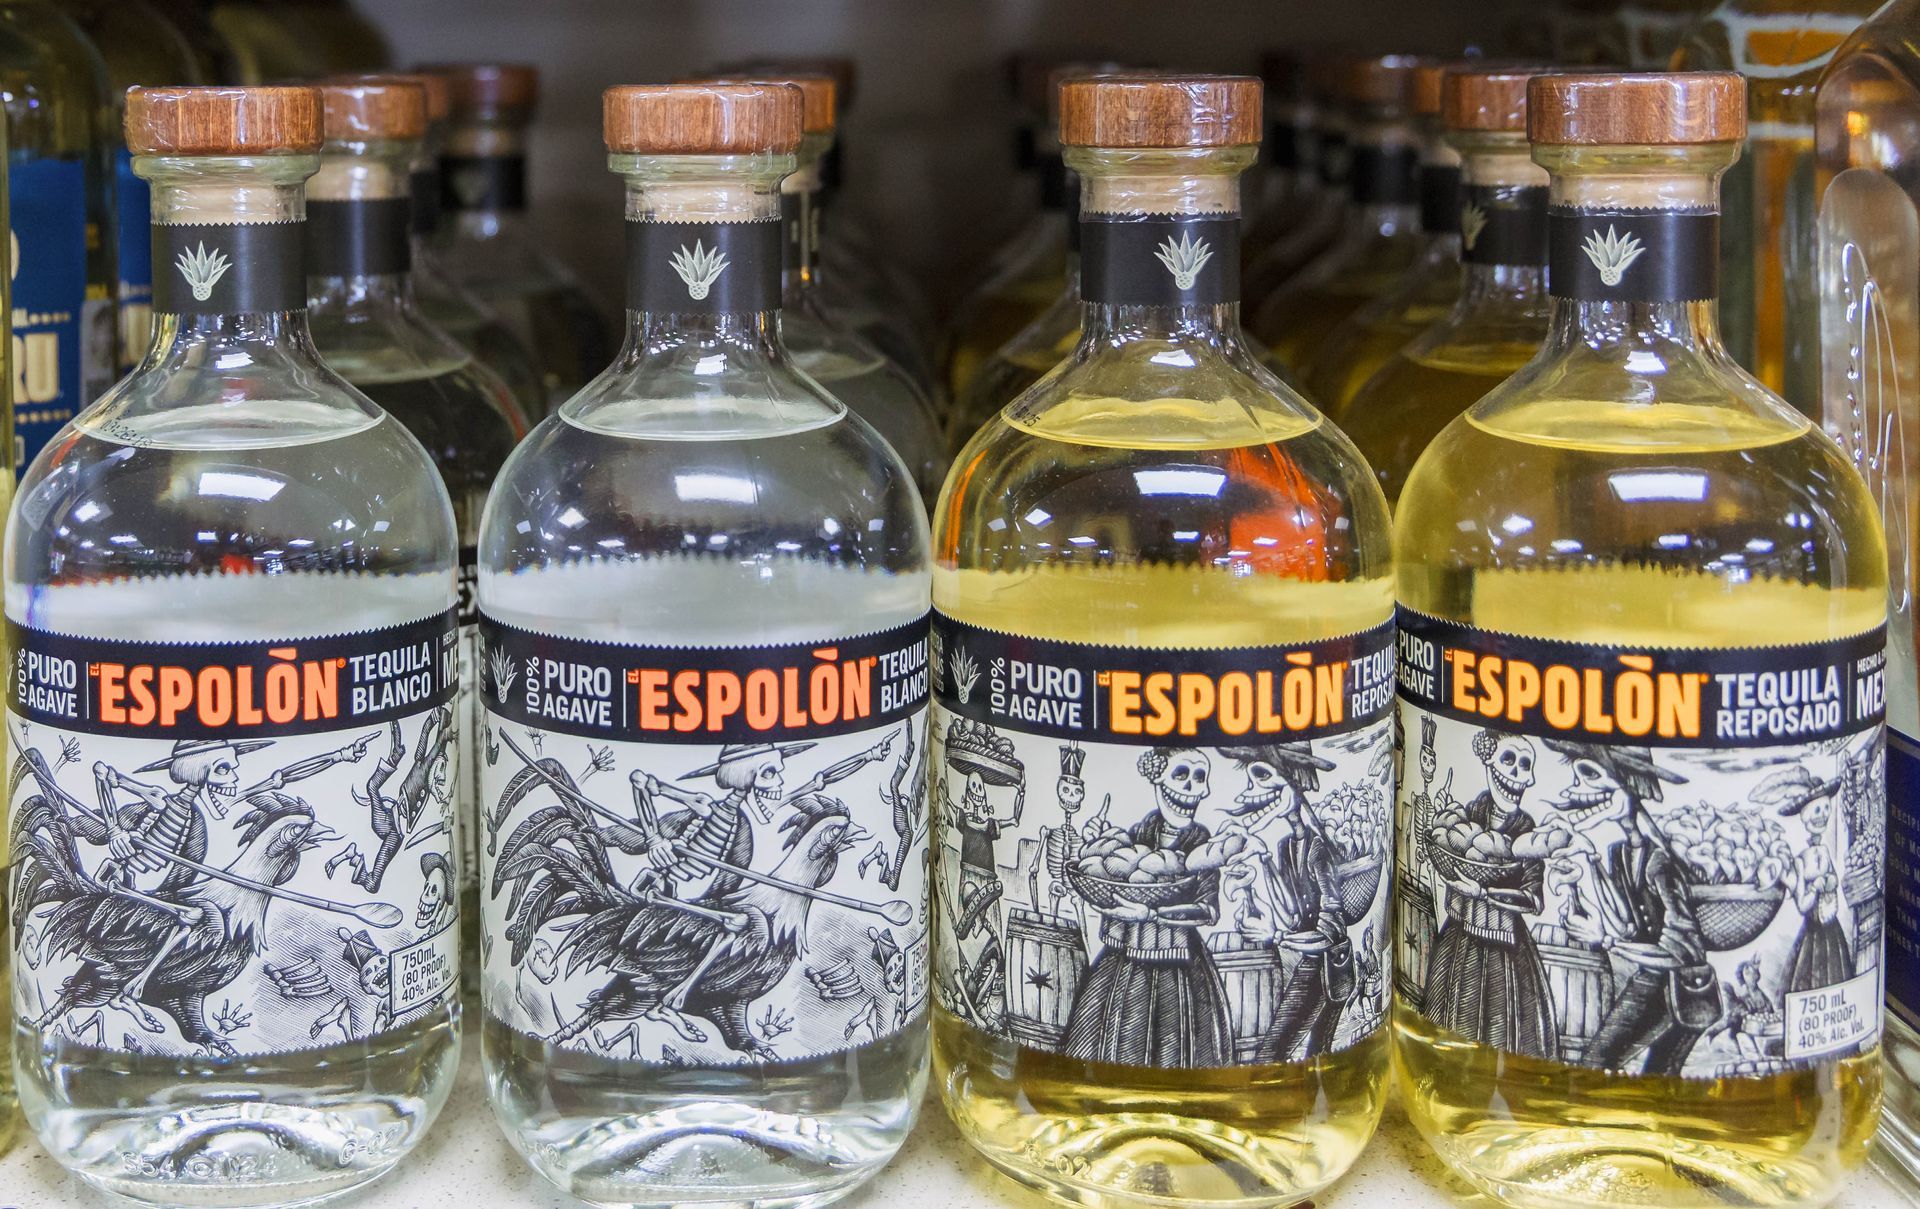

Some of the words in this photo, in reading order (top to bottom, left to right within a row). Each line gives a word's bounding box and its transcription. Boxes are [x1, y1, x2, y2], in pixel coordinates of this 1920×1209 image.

[349, 641, 431, 683] TEQUILA
[879, 636, 929, 681] TEQUILA
[1351, 641, 1395, 690] TEQUIL
[1399, 629, 1434, 671] PURO
[17, 648, 27, 704] 100%
[28, 651, 77, 690] PURO
[526, 656, 540, 714] 100%
[544, 659, 612, 698] PURO
[880, 666, 929, 713] BLANCO
[990, 657, 1006, 715] 100%
[1010, 659, 1083, 699] PURO
[1399, 661, 1435, 700] AGAVE
[1715, 665, 1841, 708] TEQUILA
[28, 684, 78, 718] AGAVE
[352, 671, 432, 715] BLANCO
[543, 693, 612, 727] AGAVE
[1009, 694, 1083, 729] AGAVE
[1716, 701, 1841, 737] REPOSADO
[402, 942, 436, 972] 750mL
[402, 969, 419, 988] (80
[421, 953, 446, 979] PROOF)
[402, 982, 425, 1002] 40%
[1799, 993, 1827, 1015] 750
[1831, 988, 1847, 1008] mL
[1798, 1032, 1827, 1048] 40%
[1830, 1025, 1848, 1042] Alc.
[1850, 1017, 1865, 1035] Vol.
[1799, 1015, 1820, 1033] (80
[1823, 1003, 1857, 1027] PROOF)
